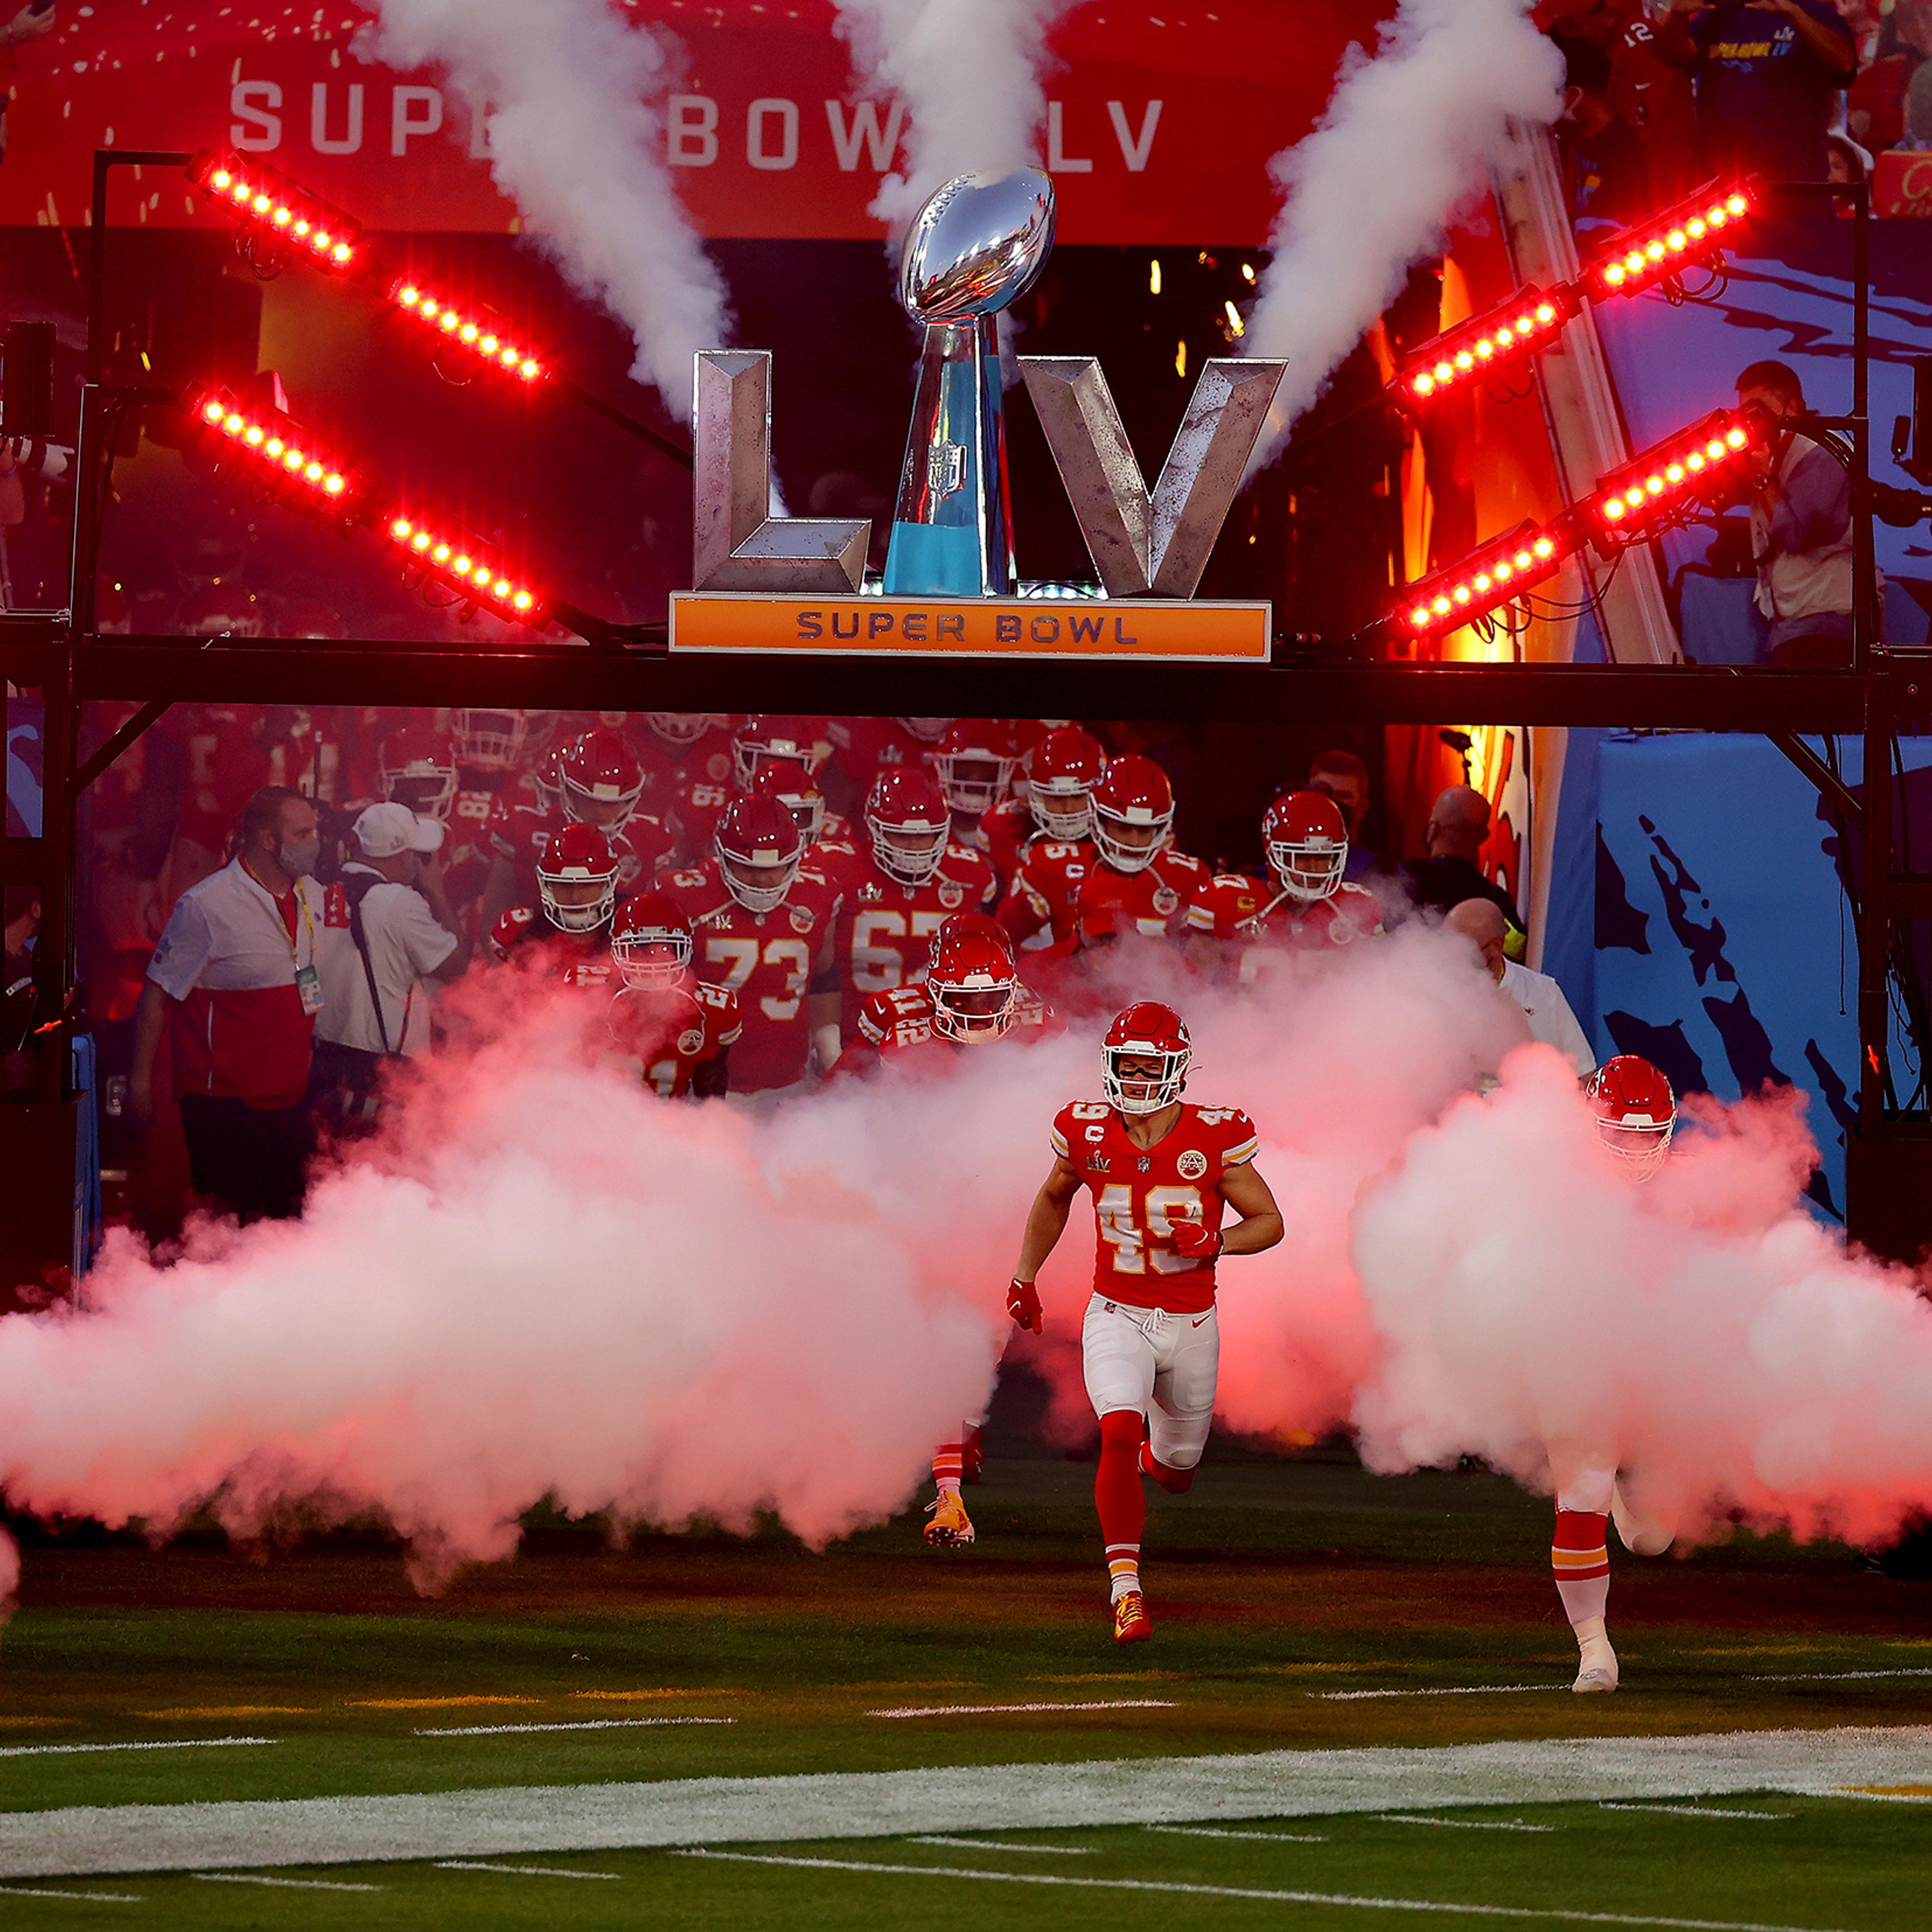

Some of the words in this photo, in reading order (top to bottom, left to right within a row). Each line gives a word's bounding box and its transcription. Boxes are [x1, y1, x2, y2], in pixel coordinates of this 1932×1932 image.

[229, 79, 496, 160] SUP
[668, 94, 908, 172] BOW
[1048, 100, 1163, 172] LV
[797, 611, 965, 641] SUPER
[996, 615, 1138, 644] BOWL
[706, 938, 810, 1020] 73
[1084, 1125, 1105, 1142] C
[1097, 1184, 1203, 1274] 49
